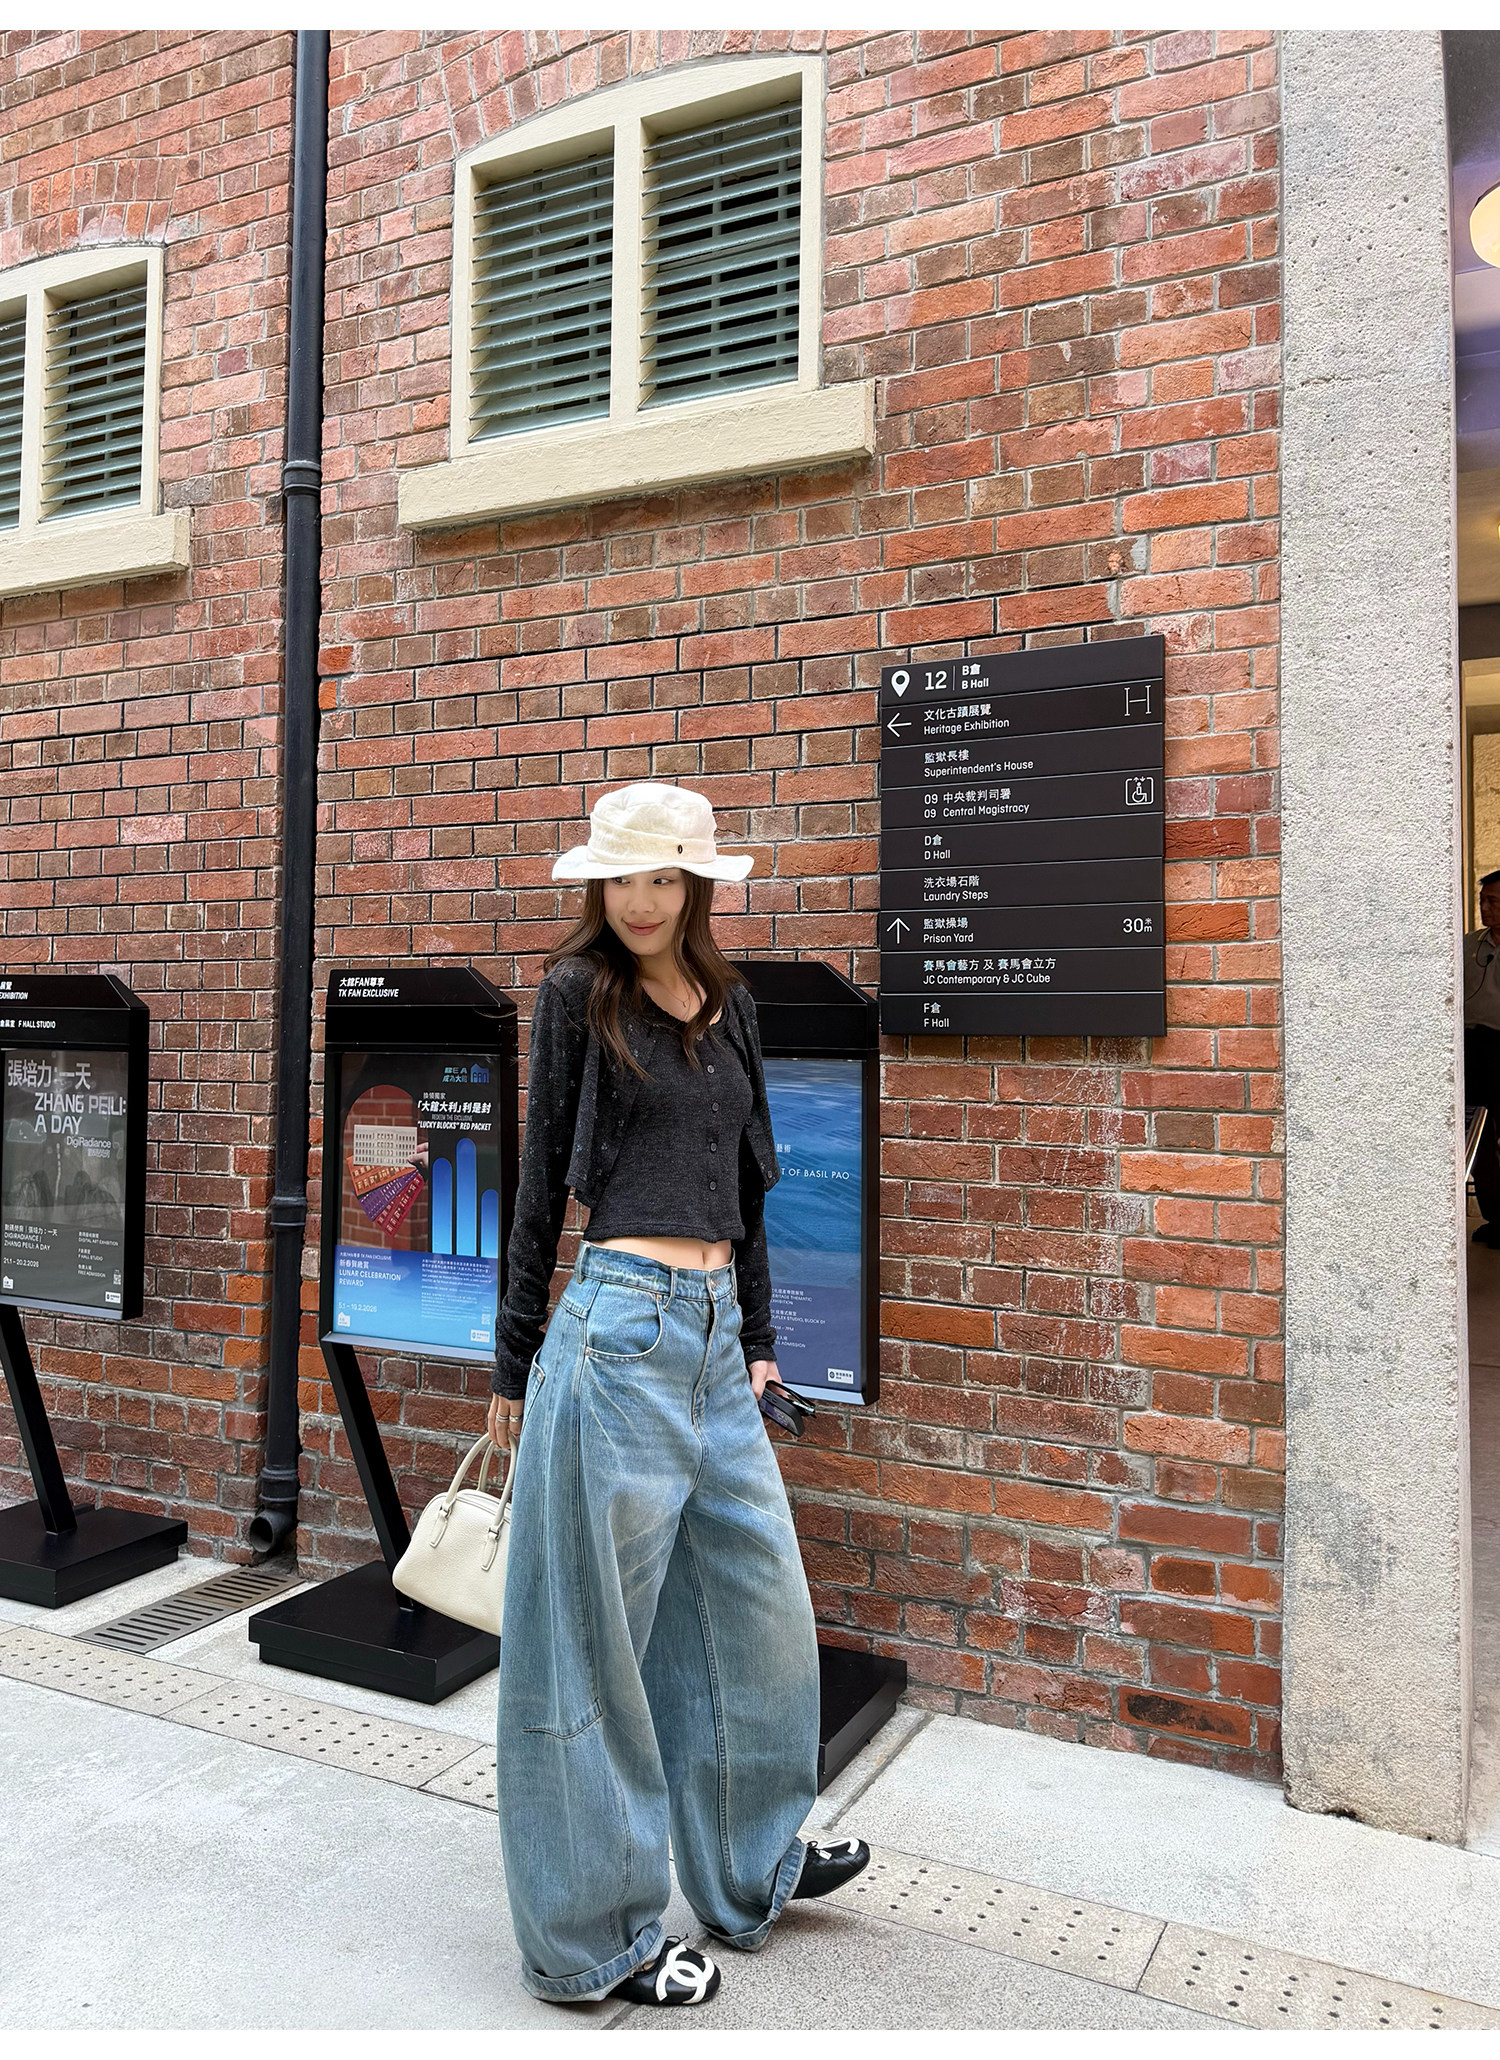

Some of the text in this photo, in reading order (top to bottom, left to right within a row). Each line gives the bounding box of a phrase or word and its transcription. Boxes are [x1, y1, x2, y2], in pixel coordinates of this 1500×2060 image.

[924, 671, 947, 690] 12
[962, 677, 989, 689] B Hall
[924, 703, 991, 721] 文化古蹟展覽
[924, 718, 1010, 735] Heritage Exhibition
[924, 749, 969, 764] 監獄長樓
[924, 760, 1034, 778] Superintendent's House
[924, 788, 1011, 804] 09 中央裁判司署
[924, 803, 1030, 818] 09 Central Magistracy
[924, 834, 943, 846] D倉
[924, 849, 951, 860] D Hall
[923, 875, 980, 888] 洗衣場石階
[923, 890, 989, 902] Laundry Steps
[923, 917, 968, 929] 監獄操場
[923, 932, 974, 943] Prison Yard
[923, 957, 1056, 972] 賽馬會藝方 及 賽馬會立方
[923, 973, 1051, 987] JC Contemporary & JC Cube
[338, 989, 399, 997] TK FAN EXCLUSIVE
[923, 1002, 941, 1014] F倉
[924, 1018, 949, 1028] F Hall
[34, 1092, 126, 1116] ZHANG PEILI:
[34, 1114, 82, 1134] A DAY
[459, 1122, 470, 1130] RED
[470, 1123, 492, 1131] PACKET
[66, 1136, 111, 1149] DigiRadiance
[788, 1168, 800, 1176] OF
[804, 1170, 828, 1178] BASIL
[832, 1171, 849, 1180] PAO
[4, 1232, 39, 1242] DIGIRADIANCE
[4, 1240, 21, 1248] ZHANG
[40, 1243, 51, 1251] DAY
[339, 1269, 401, 1281] LUNAR CELEBRATION
[339, 1278, 364, 1287] REWARD
